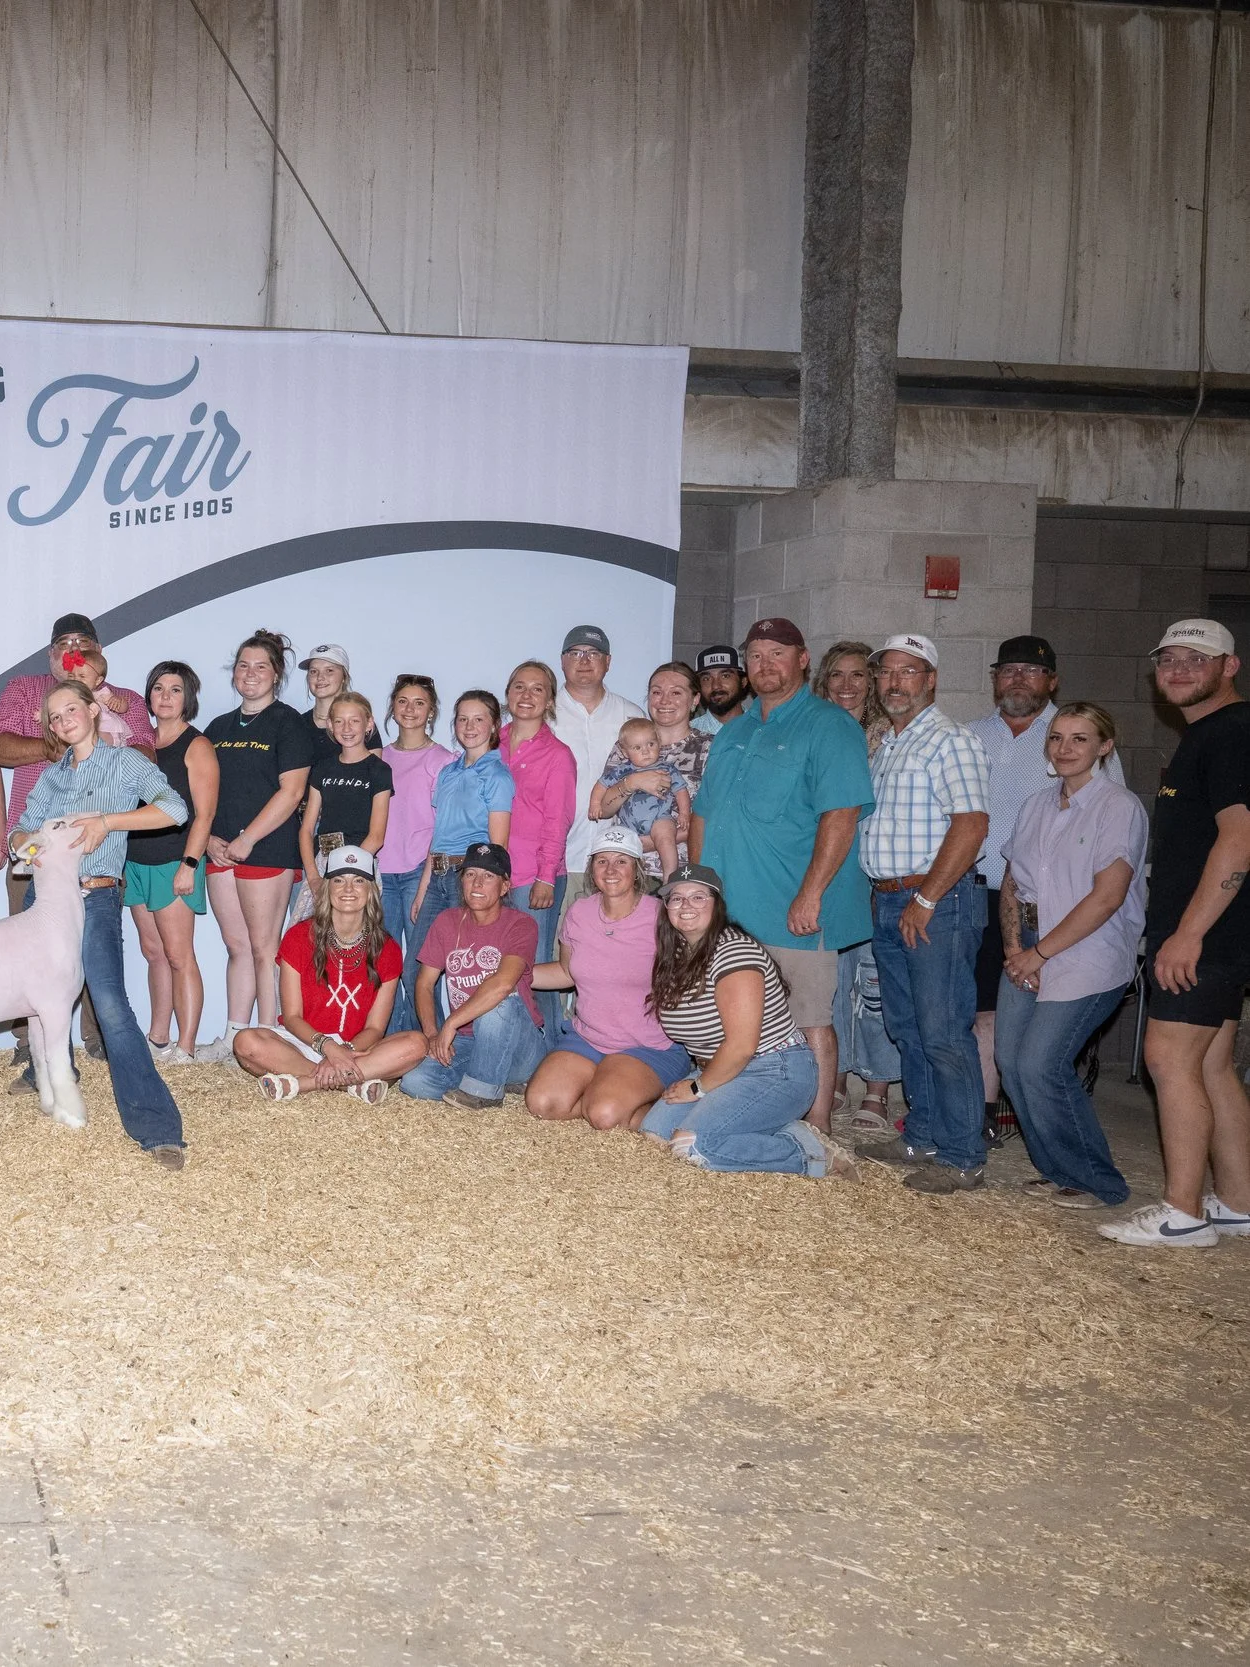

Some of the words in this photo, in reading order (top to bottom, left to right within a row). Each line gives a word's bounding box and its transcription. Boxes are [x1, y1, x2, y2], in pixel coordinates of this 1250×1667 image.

[7, 355, 251, 527] Fair
[109, 504, 177, 529] SINCE
[184, 497, 234, 521] 1905
[250, 741, 270, 751] TIME
